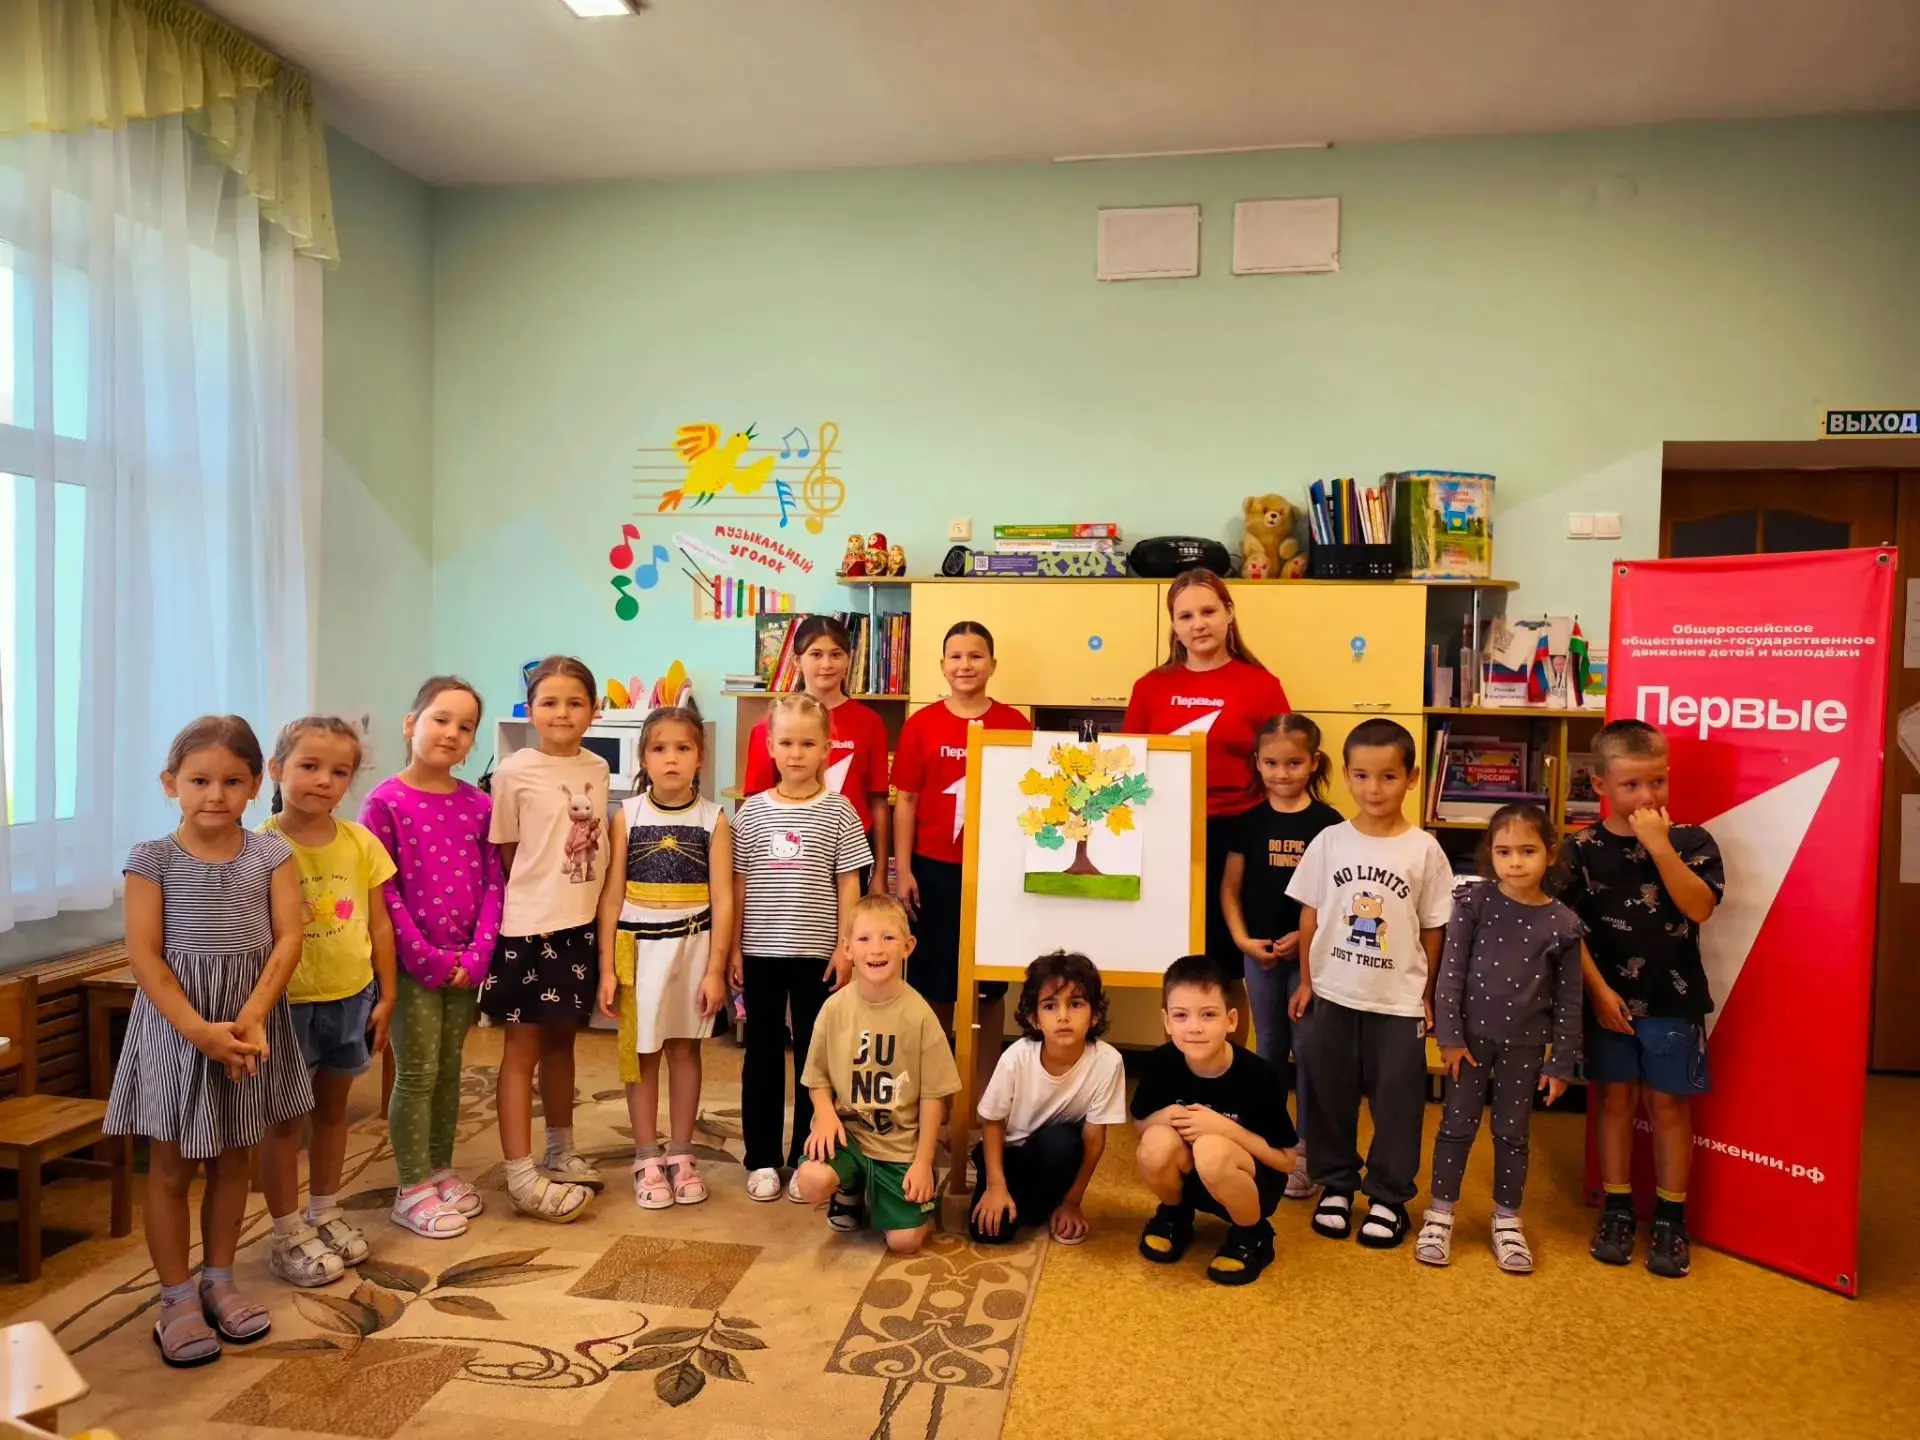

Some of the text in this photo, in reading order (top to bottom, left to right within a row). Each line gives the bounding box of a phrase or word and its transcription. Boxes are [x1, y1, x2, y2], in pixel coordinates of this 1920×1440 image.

[1830, 413, 1918, 433] ВЫХОД
[714, 525, 815, 574] МУЗЫКАЛЬНЫЙ
[729, 544, 787, 574] УГОЛОК
[1621, 635, 1876, 647] общественно-государственное
[1672, 623, 1814, 635] Общероссийское
[1631, 646, 1861, 659] движение детей и молодёжи
[1170, 695, 1225, 709] Первые
[1636, 685, 1848, 741] Первые
[940, 746, 968, 760] Пер
[1333, 865, 1411, 899] NO LIMITS
[1330, 946, 1396, 970] JUST TRICKS.
[853, 1032, 896, 1067] JU
[851, 1070, 895, 1104] NG
